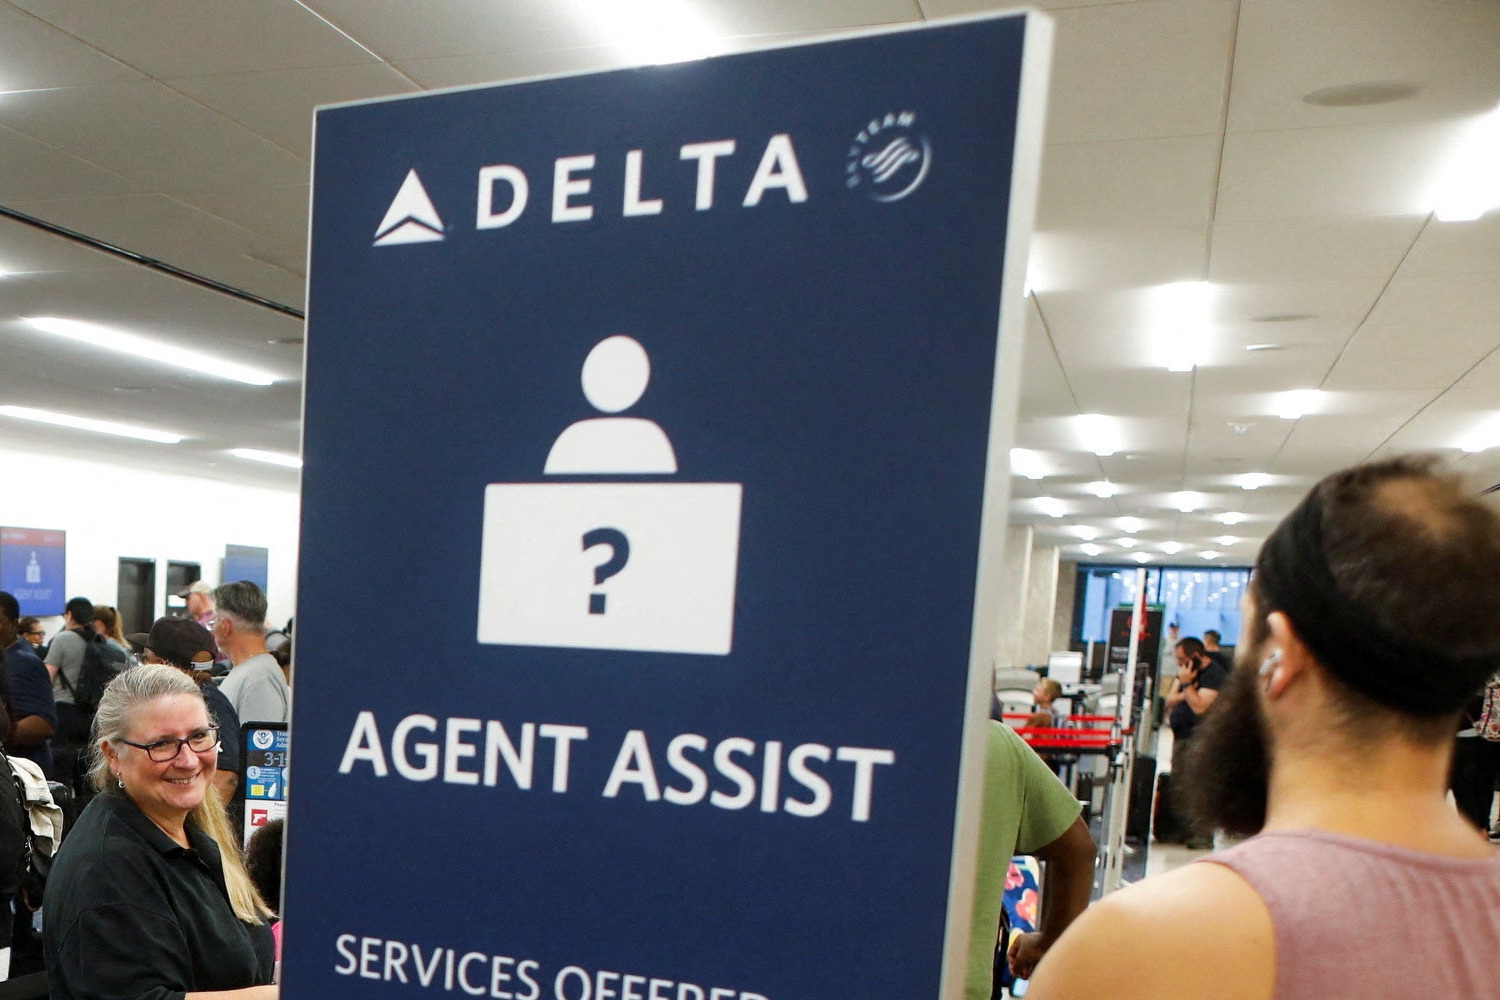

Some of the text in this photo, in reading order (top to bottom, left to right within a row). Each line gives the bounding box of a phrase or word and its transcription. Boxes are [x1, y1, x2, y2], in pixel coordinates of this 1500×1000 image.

[475, 133, 809, 231] DELTA
[337, 710, 896, 824] AGENT ASSIST
